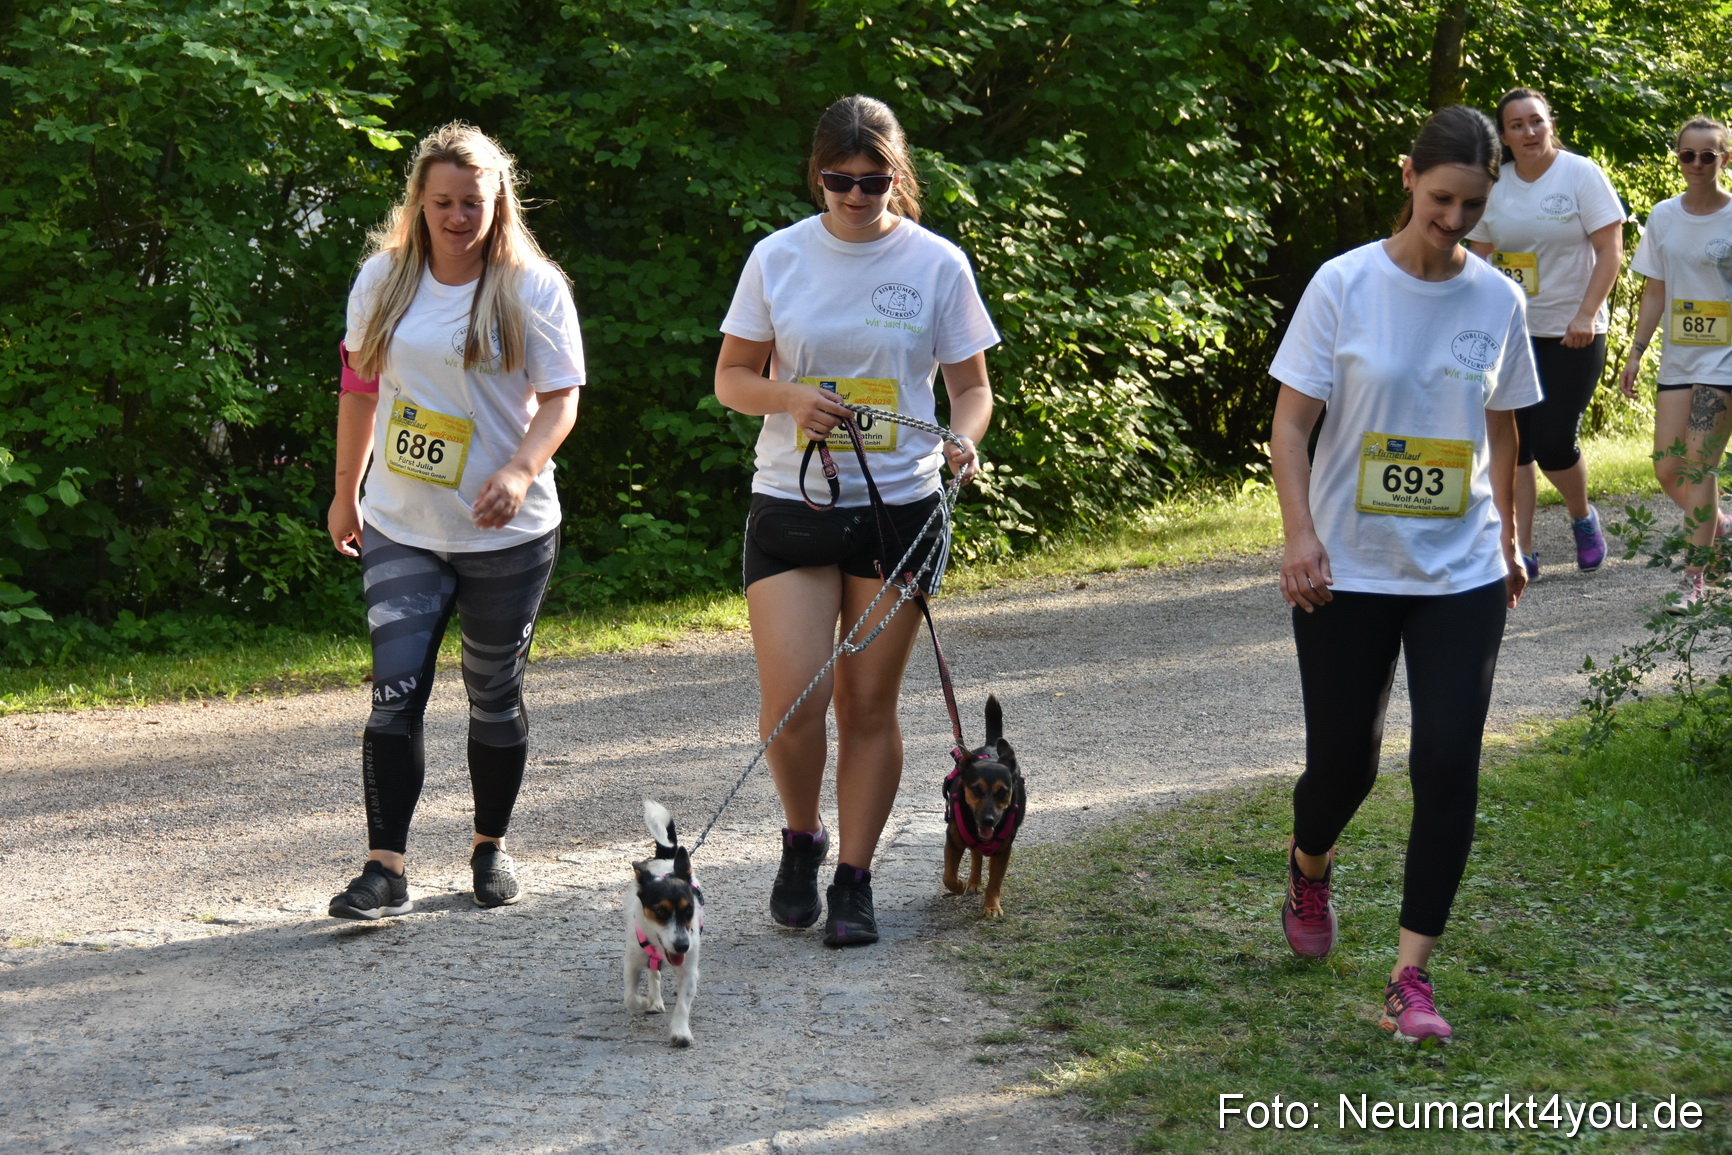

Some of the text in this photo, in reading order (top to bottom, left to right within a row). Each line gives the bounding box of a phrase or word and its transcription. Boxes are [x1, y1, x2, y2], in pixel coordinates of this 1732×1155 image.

[1497, 267, 1524, 284] 83
[877, 304, 916, 318] NATURKOST
[1683, 316, 1716, 333] 687
[396, 429, 446, 464] 686
[415, 462, 434, 471] Julia
[1382, 464, 1444, 496] 693
[1392, 494, 1432, 505] Wolf Anja
[365, 741, 384, 830] STRNGR EVRY DY
